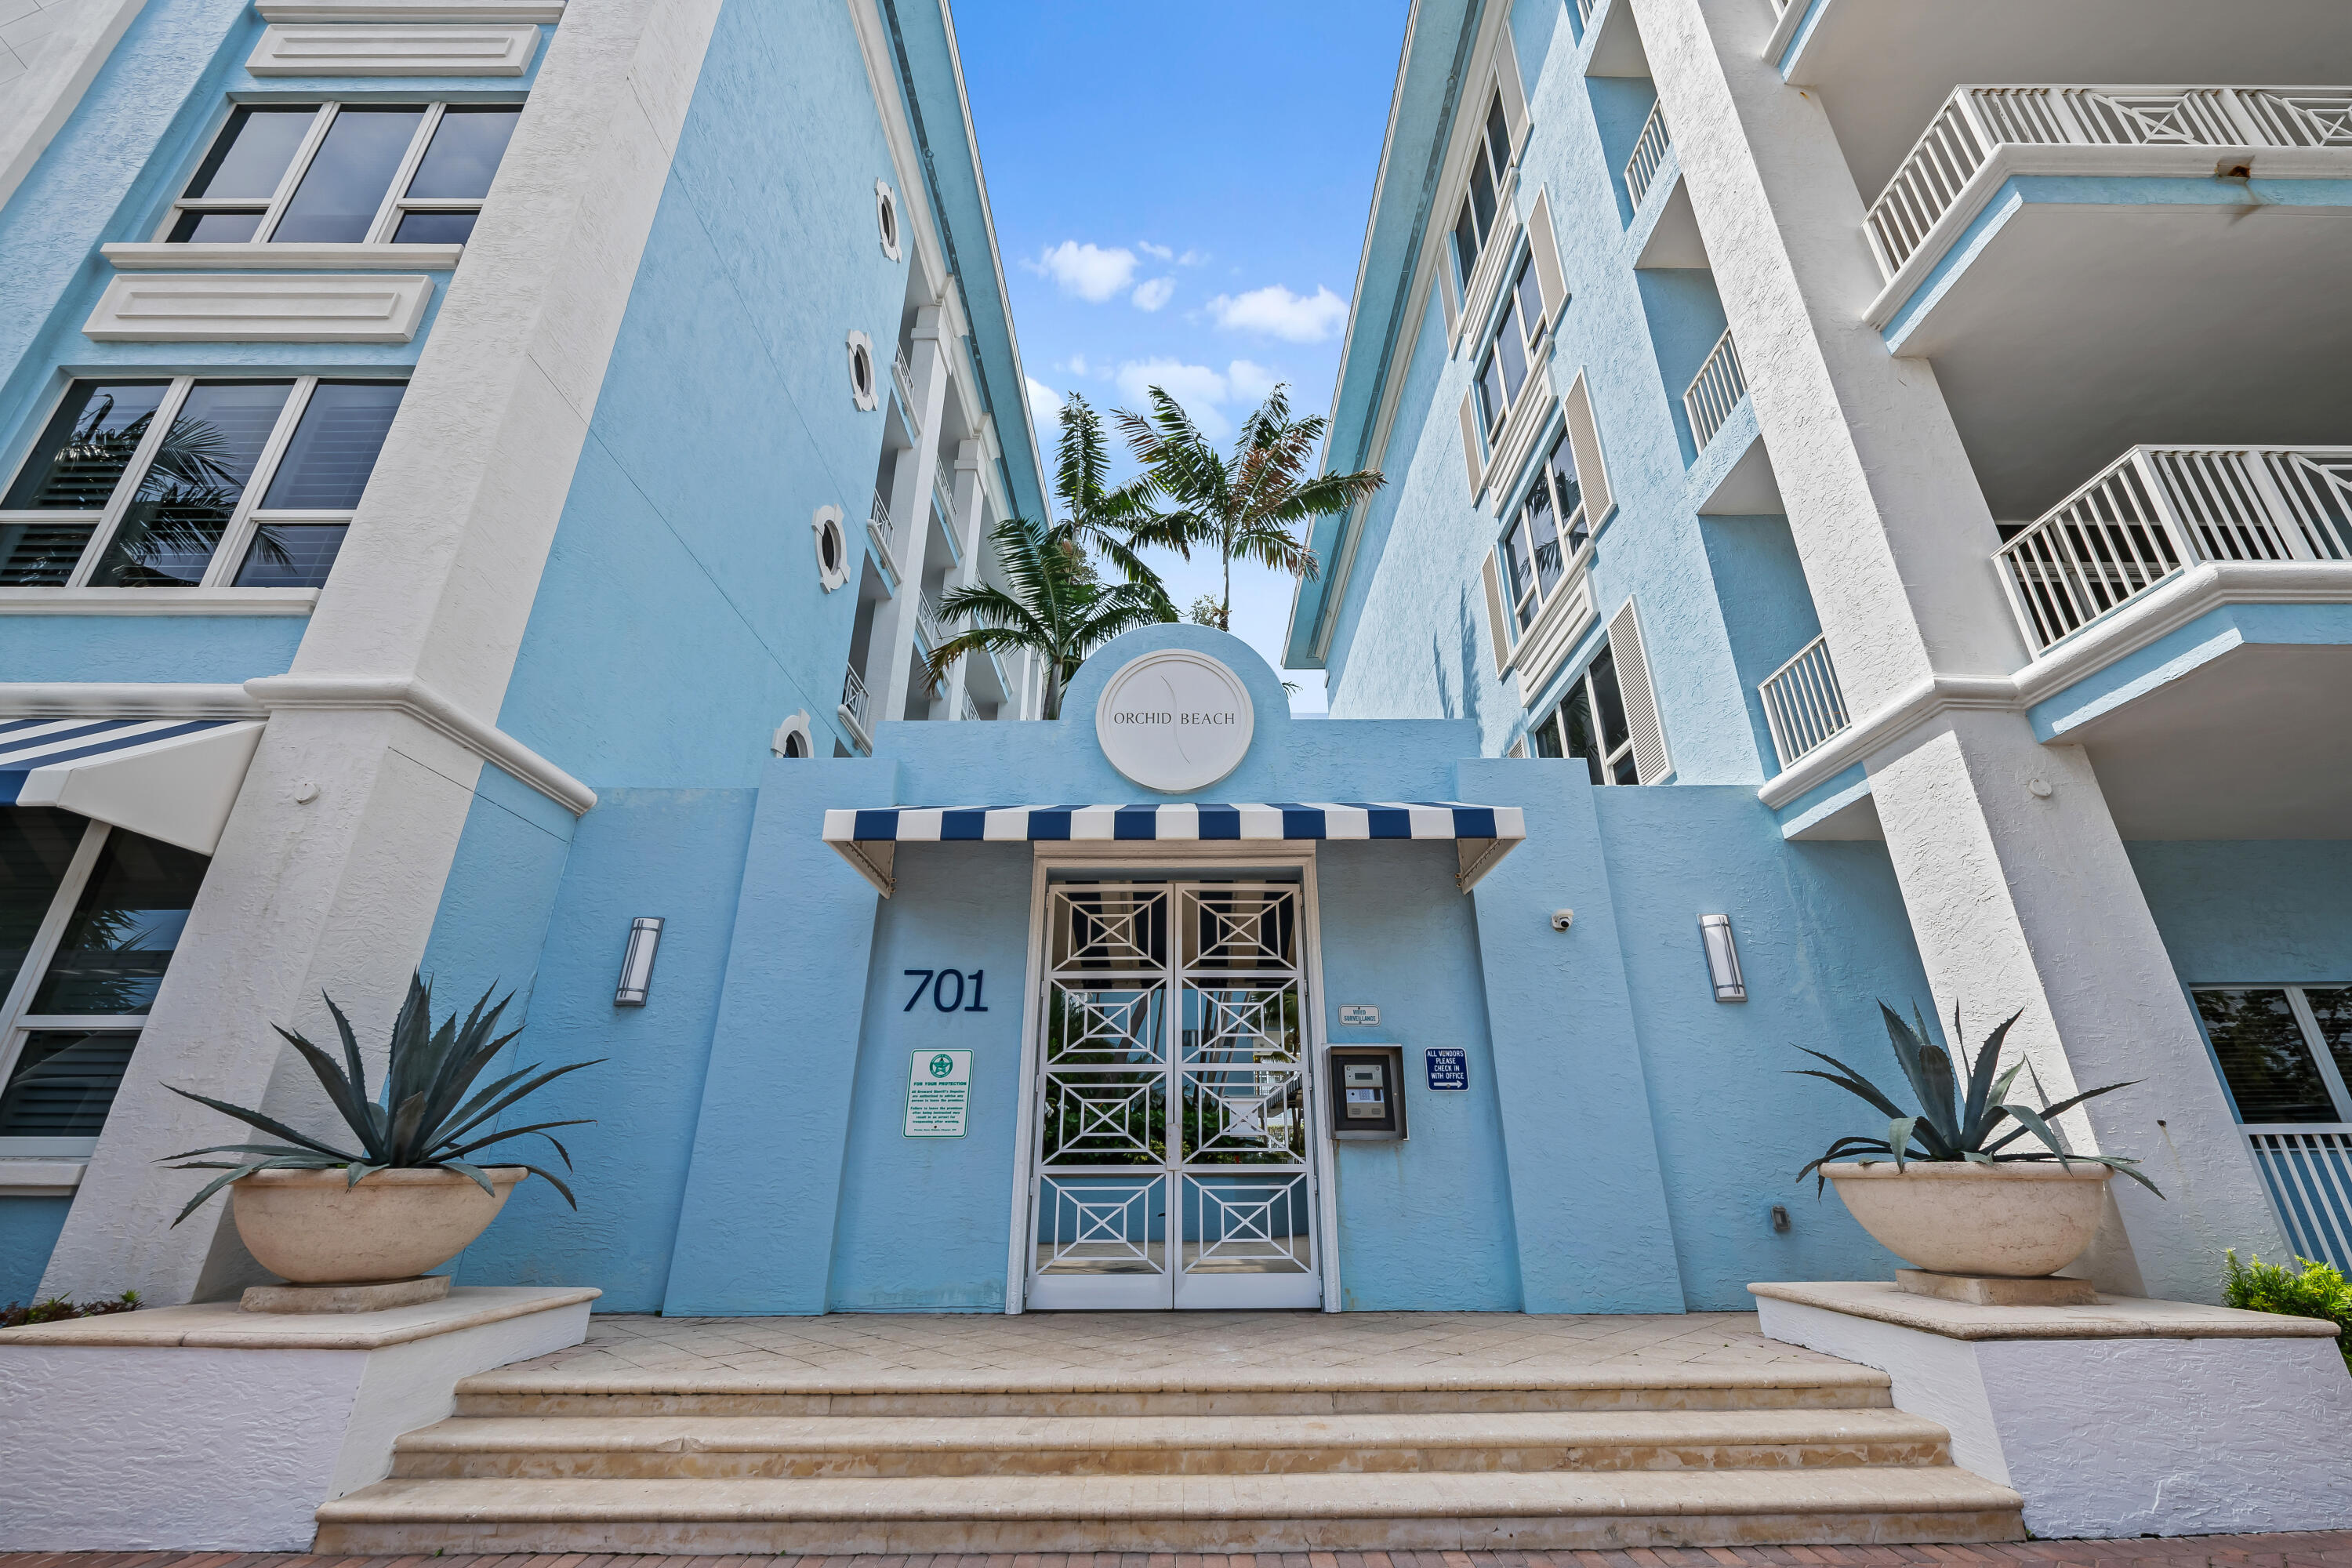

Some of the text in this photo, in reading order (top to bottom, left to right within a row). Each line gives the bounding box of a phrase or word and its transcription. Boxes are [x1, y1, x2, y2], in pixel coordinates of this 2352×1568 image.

[1113, 712, 1236, 724] ORCHID BEACH
[903, 968, 989, 1013] 701
